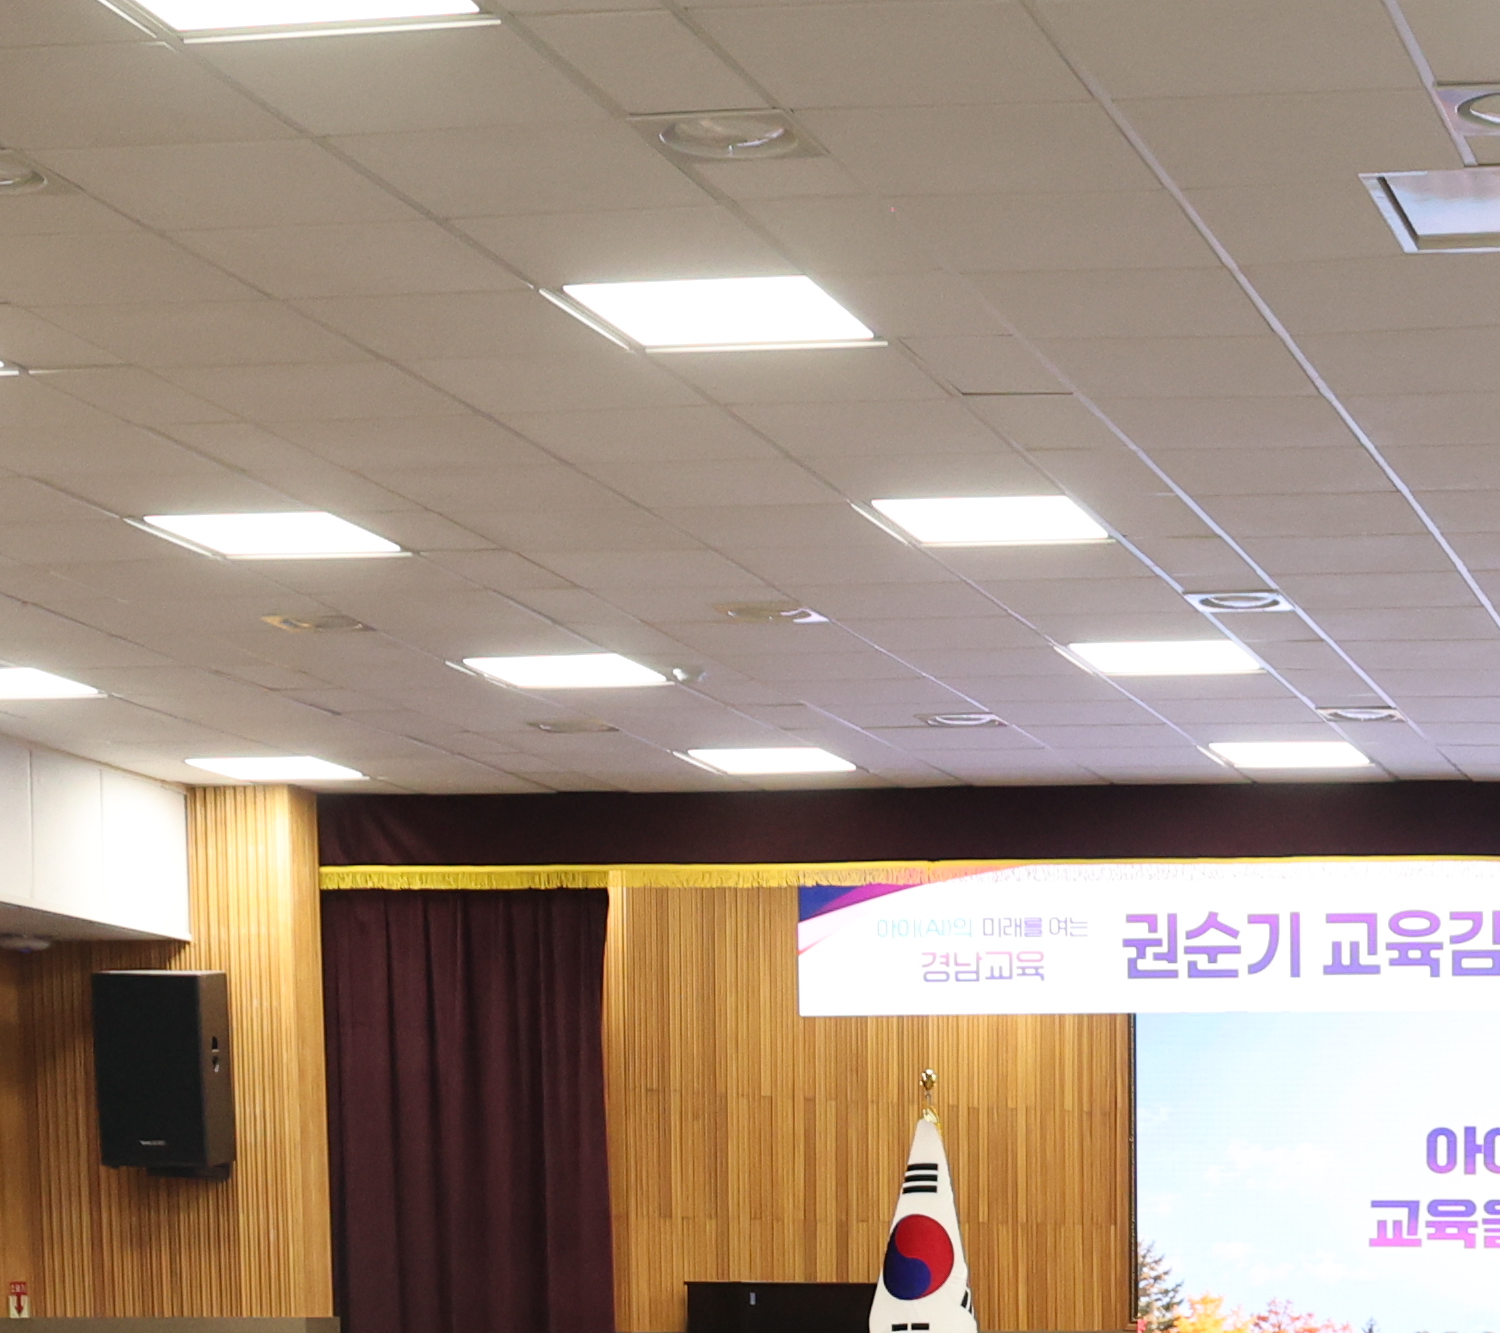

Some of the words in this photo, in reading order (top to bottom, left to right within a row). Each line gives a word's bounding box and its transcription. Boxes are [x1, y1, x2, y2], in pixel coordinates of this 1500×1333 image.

[982, 917, 1043, 938] 미래를
[1049, 917, 1088, 938] 여는
[1122, 911, 1300, 979] 권순기
[921, 951, 1045, 982] 경남교육
